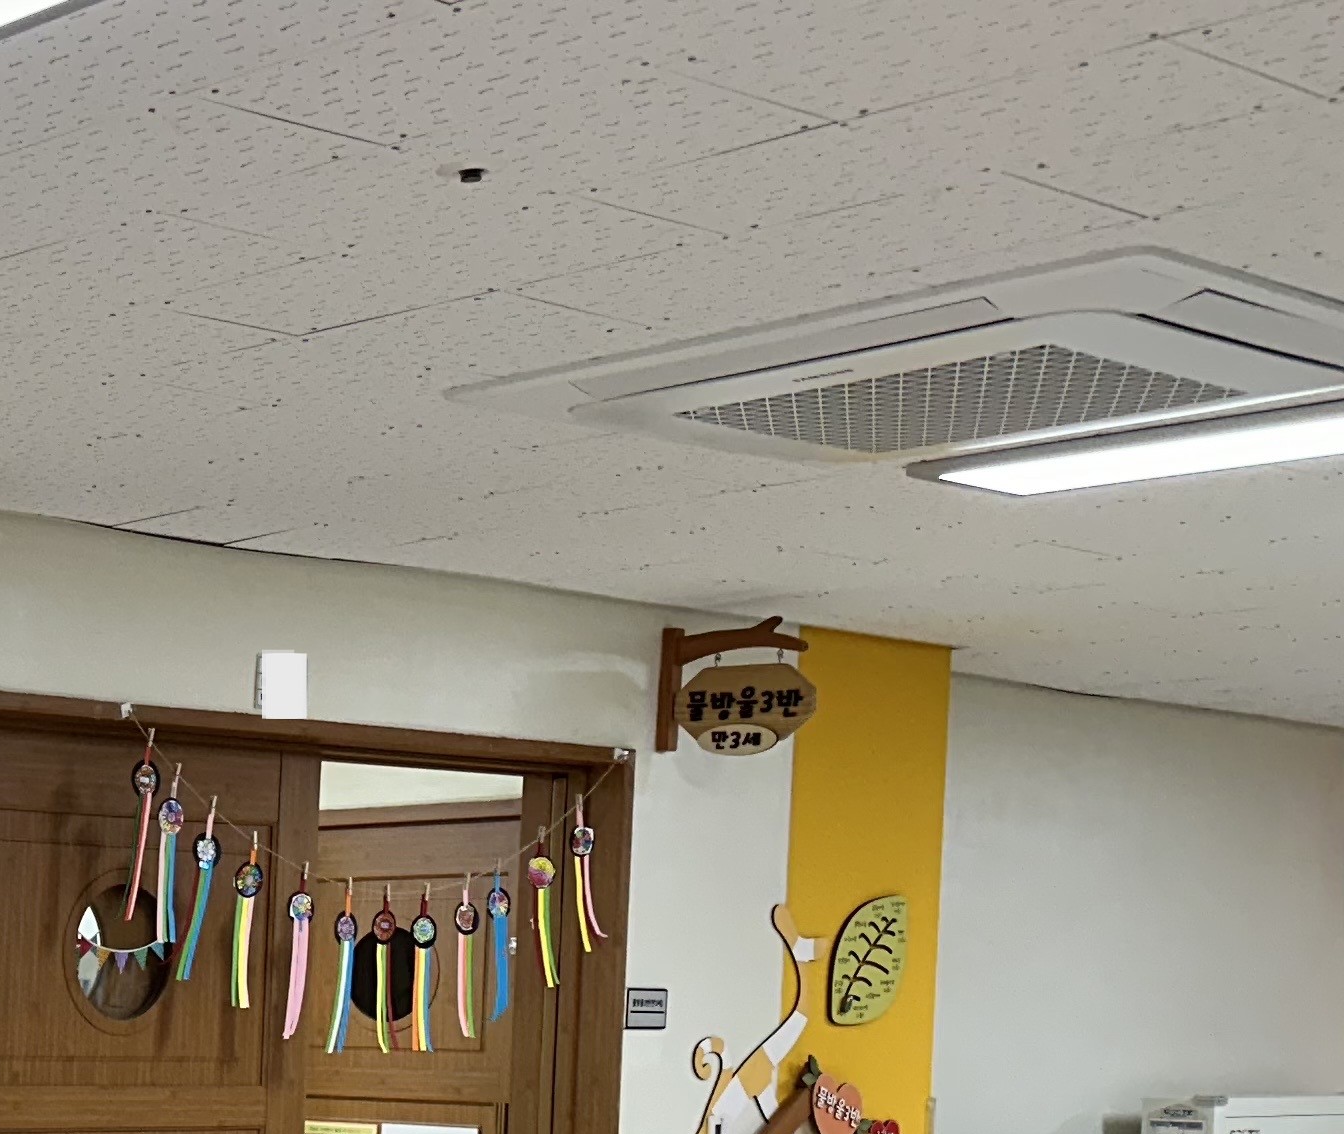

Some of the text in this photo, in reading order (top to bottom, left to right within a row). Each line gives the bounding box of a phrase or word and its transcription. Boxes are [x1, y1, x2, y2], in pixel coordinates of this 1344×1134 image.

[687, 687, 803, 721] 물방울3반
[711, 731, 761, 750] 만3세
[817, 1086, 861, 1128] 물방울3반
